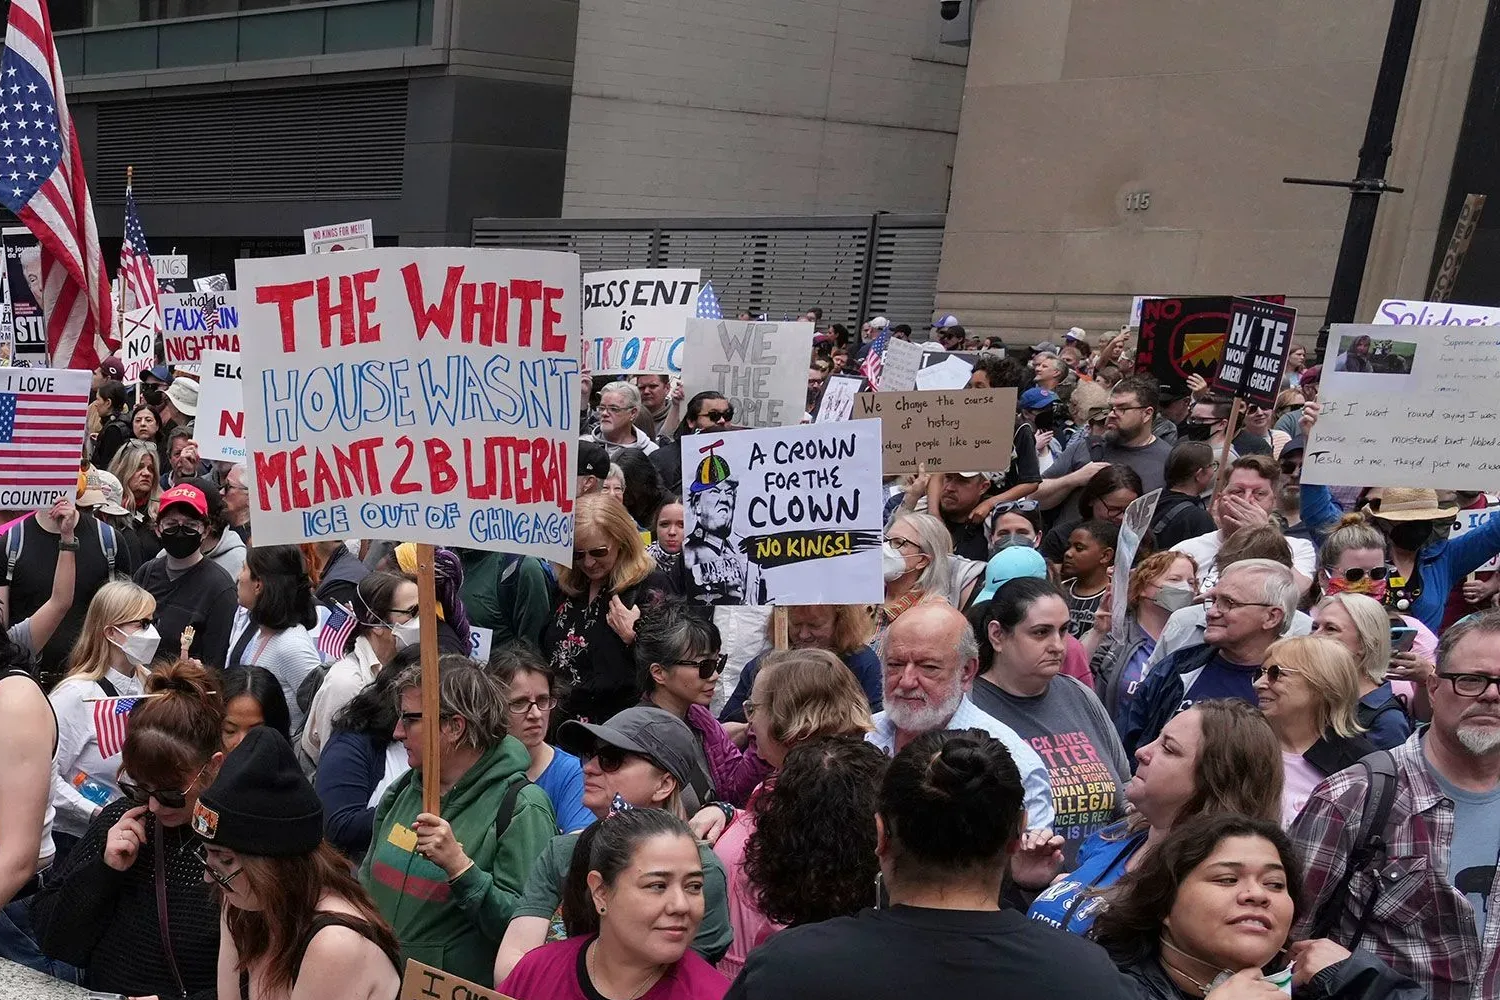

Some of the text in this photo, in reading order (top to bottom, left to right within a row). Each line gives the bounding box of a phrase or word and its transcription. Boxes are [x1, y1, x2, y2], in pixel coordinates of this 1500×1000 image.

[1126, 192, 1151, 211] 115
[321, 228, 338, 240] KINGS
[339, 226, 349, 236] FOR
[583, 279, 700, 311] DISSENT
[255, 262, 569, 353] THE WHITE
[1143, 299, 1183, 321] NO
[164, 307, 207, 331] FAUX
[620, 310, 636, 332] is
[128, 335, 151, 359] NO
[716, 320, 780, 366] WE
[1253, 355, 1281, 373] MAKE
[7, 375, 55, 393] I LOVE
[711, 364, 772, 399] THE
[1250, 374, 1276, 393] GREAT
[262, 354, 579, 443] HOUSE WASN'T
[861, 394, 994, 415] We change the course
[901, 415, 960, 430] of history
[1319, 401, 1340, 417] If
[1343, 402, 1359, 418] I
[1365, 407, 1390, 418] went
[1441, 412, 1466, 424] saying
[1467, 411, 1477, 419] I
[1480, 411, 1497, 421] was
[915, 437, 992, 451] people like you
[1314, 432, 1348, 444] because
[1391, 434, 1440, 446] moistened
[1444, 433, 1467, 446] bint
[748, 432, 857, 471] A CROWN
[899, 456, 942, 467] and me
[1308, 451, 1471, 474] Tesla at put me
[253, 435, 574, 514] MEANT 2 B LITERAL
[764, 465, 843, 493] FOR THE
[748, 488, 861, 529] CLOWN
[303, 502, 575, 548] ICE OUT OF CHICAGO!
[755, 531, 851, 559] NO KINGS!
[1053, 731, 1091, 747] LIVES
[1071, 762, 1109, 775] RIGHTS
[1081, 771, 1113, 784] RIGHTS
[1088, 781, 1117, 795] BEING
[1053, 791, 1117, 815] ILLEGAL
[1078, 813, 1090, 825] IS
[1067, 825, 1081, 840] IS
[421, 970, 446, 1000] I
